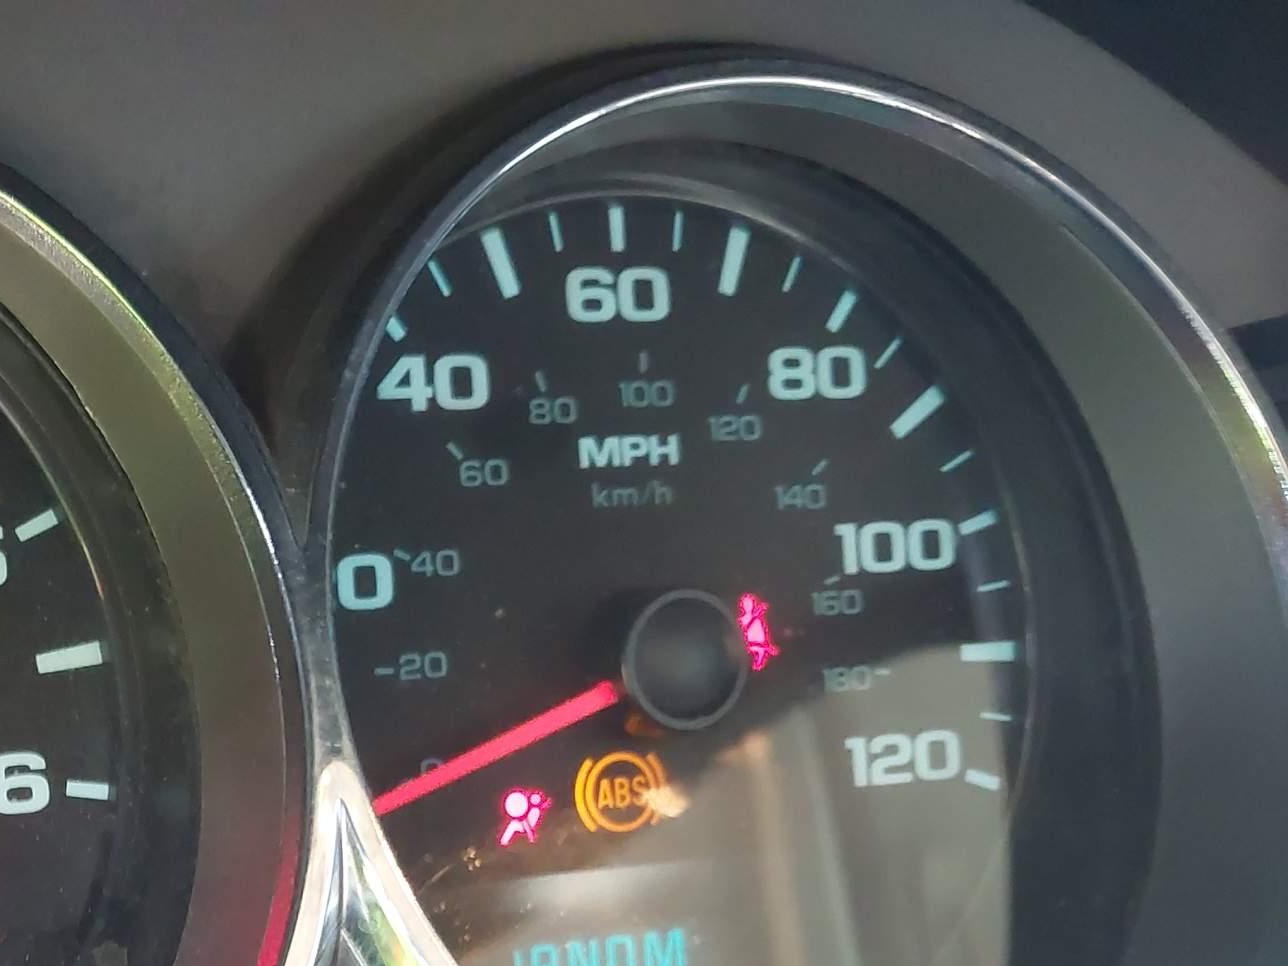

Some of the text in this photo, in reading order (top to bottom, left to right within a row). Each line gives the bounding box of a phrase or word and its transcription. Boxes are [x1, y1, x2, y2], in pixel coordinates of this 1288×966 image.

[565, 266, 671, 323] 60
[376, 354, 490, 412] 40
[768, 346, 865, 400] 80
[619, 380, 674, 408] 100
[528, 397, 577, 424] 80
[710, 414, 762, 441] 120
[578, 434, 680, 469] MPH
[459, 459, 508, 487] 60
[591, 482, 673, 509] km/h
[776, 484, 825, 510] 140
[834, 520, 956, 576] 100
[410, 549, 460, 576] 40
[812, 589, 863, 615] 160
[399, 651, 448, 681] 20
[823, 666, 872, 693] 180
[844, 730, 961, 788] 120
[598, 773, 648, 809] ABS
